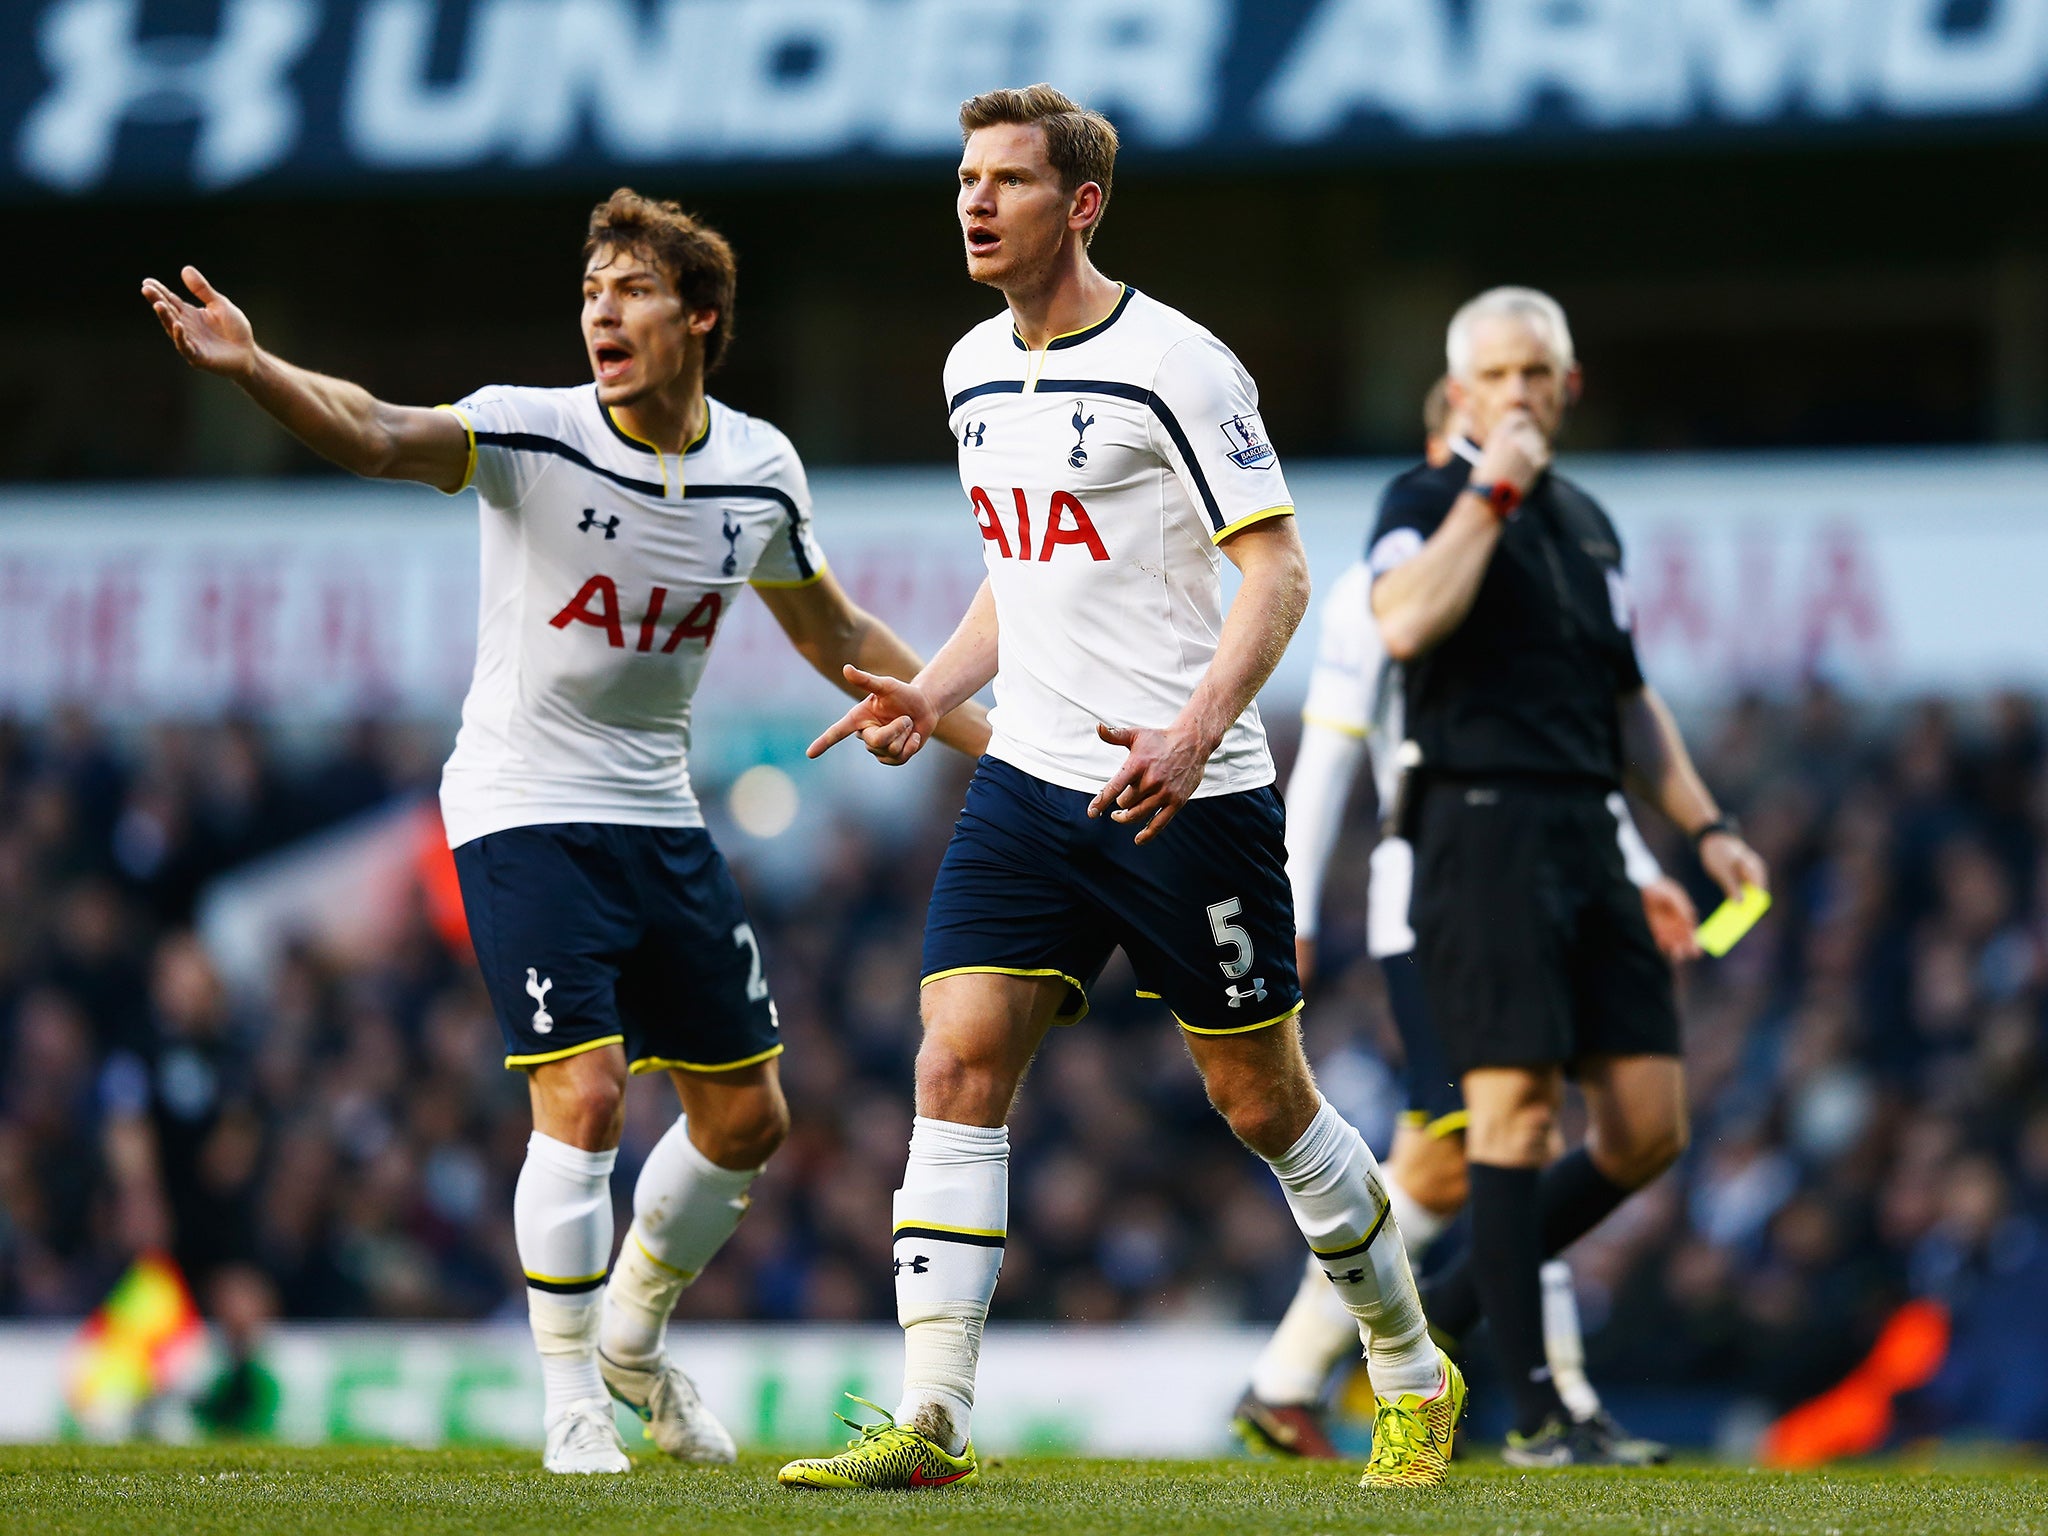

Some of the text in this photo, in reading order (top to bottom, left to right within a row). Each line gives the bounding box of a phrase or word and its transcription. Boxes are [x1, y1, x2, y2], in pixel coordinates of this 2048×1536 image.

[970, 486, 1110, 562] AIA
[549, 574, 722, 655] AIA
[732, 922, 768, 1003] 2
[1206, 896, 1254, 979] 5
